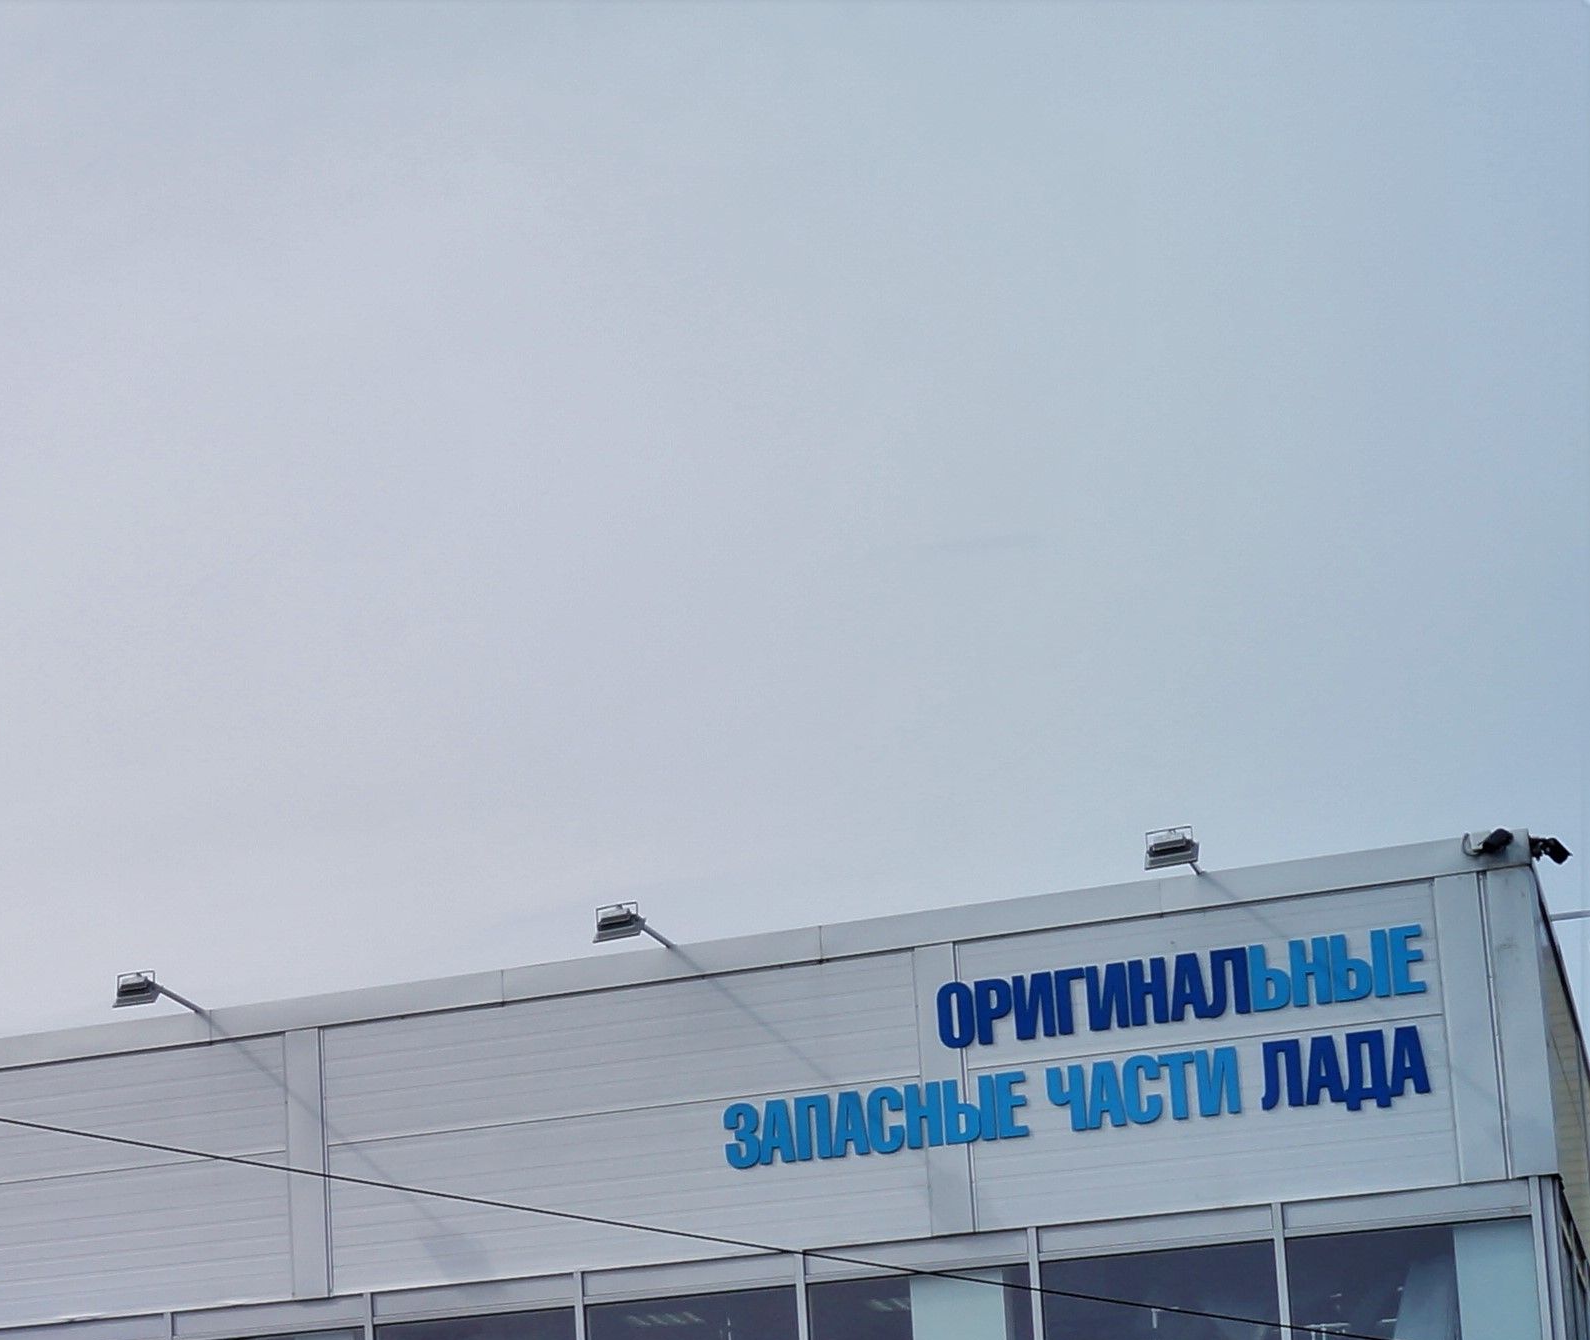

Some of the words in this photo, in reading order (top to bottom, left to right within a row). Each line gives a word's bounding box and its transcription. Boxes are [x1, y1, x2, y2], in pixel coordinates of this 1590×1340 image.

[936, 923, 1427, 1050] ОРИГИНАЛЬНЫЕ
[723, 1068, 1030, 1170] ЗАПАСНЫЕ
[1045, 1045, 1242, 1132] ЧАСТИ
[1261, 1025, 1430, 1112] ЛАДА
